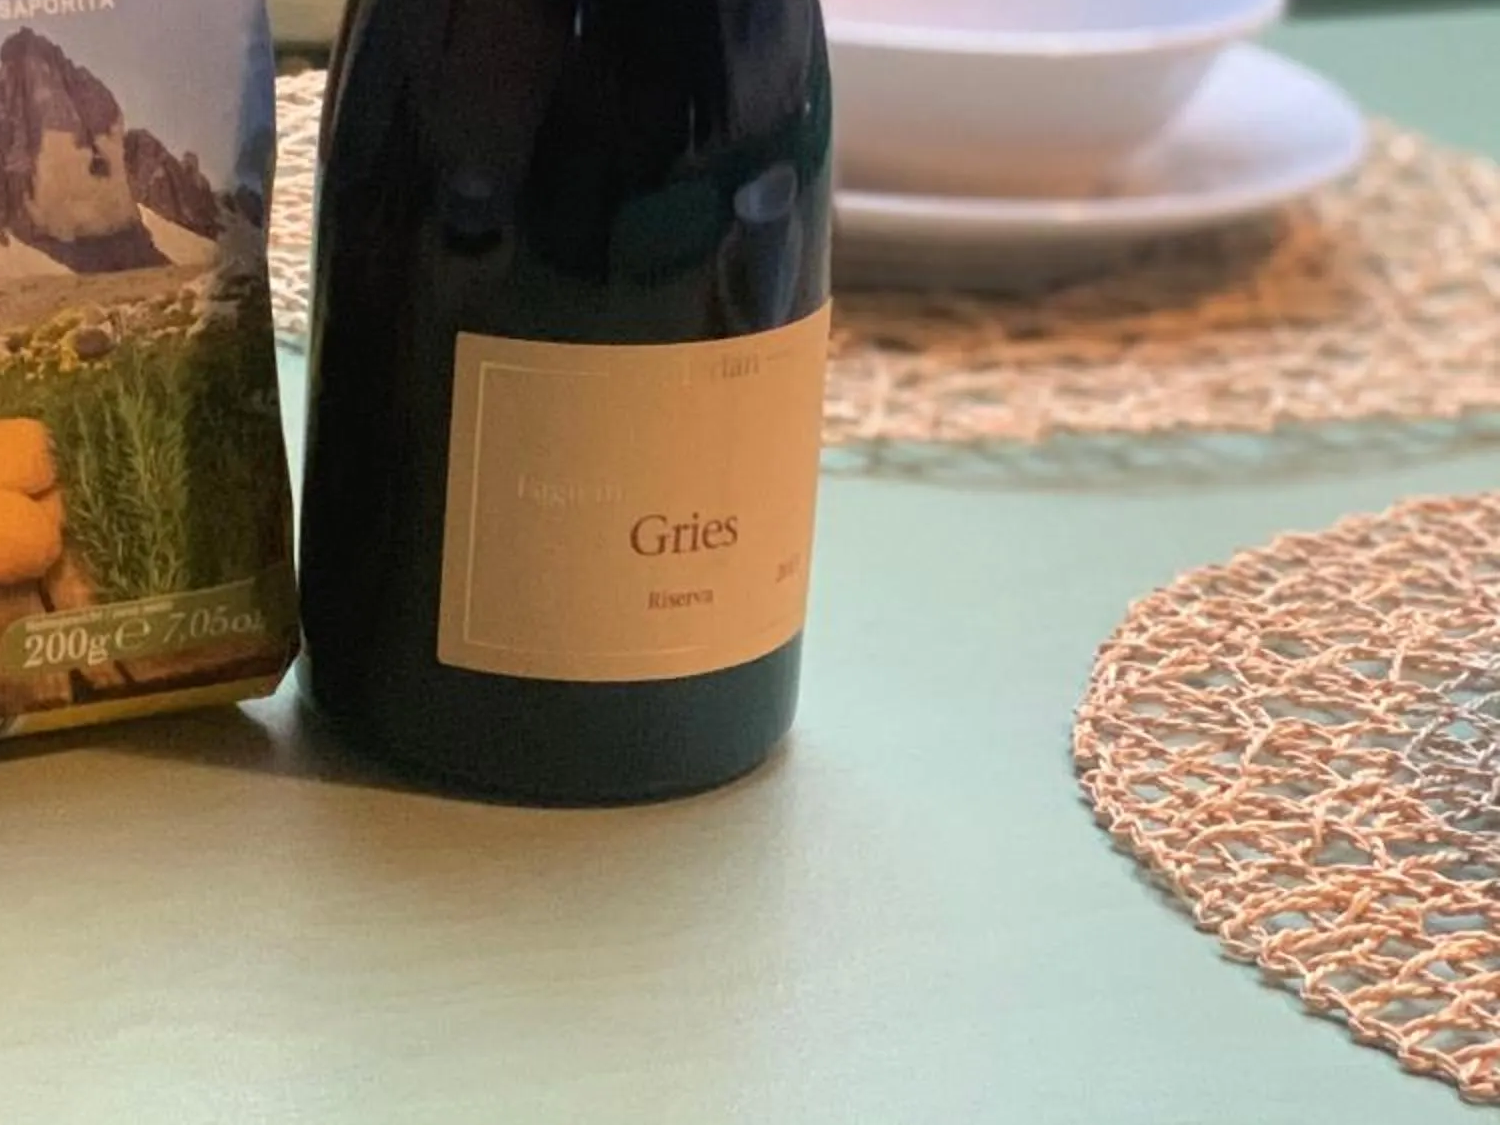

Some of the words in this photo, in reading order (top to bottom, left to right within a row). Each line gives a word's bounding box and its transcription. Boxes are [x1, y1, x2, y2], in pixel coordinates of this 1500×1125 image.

[628, 511, 740, 557] Gries
[647, 588, 714, 612] Riserva
[23, 625, 112, 669] 200g
